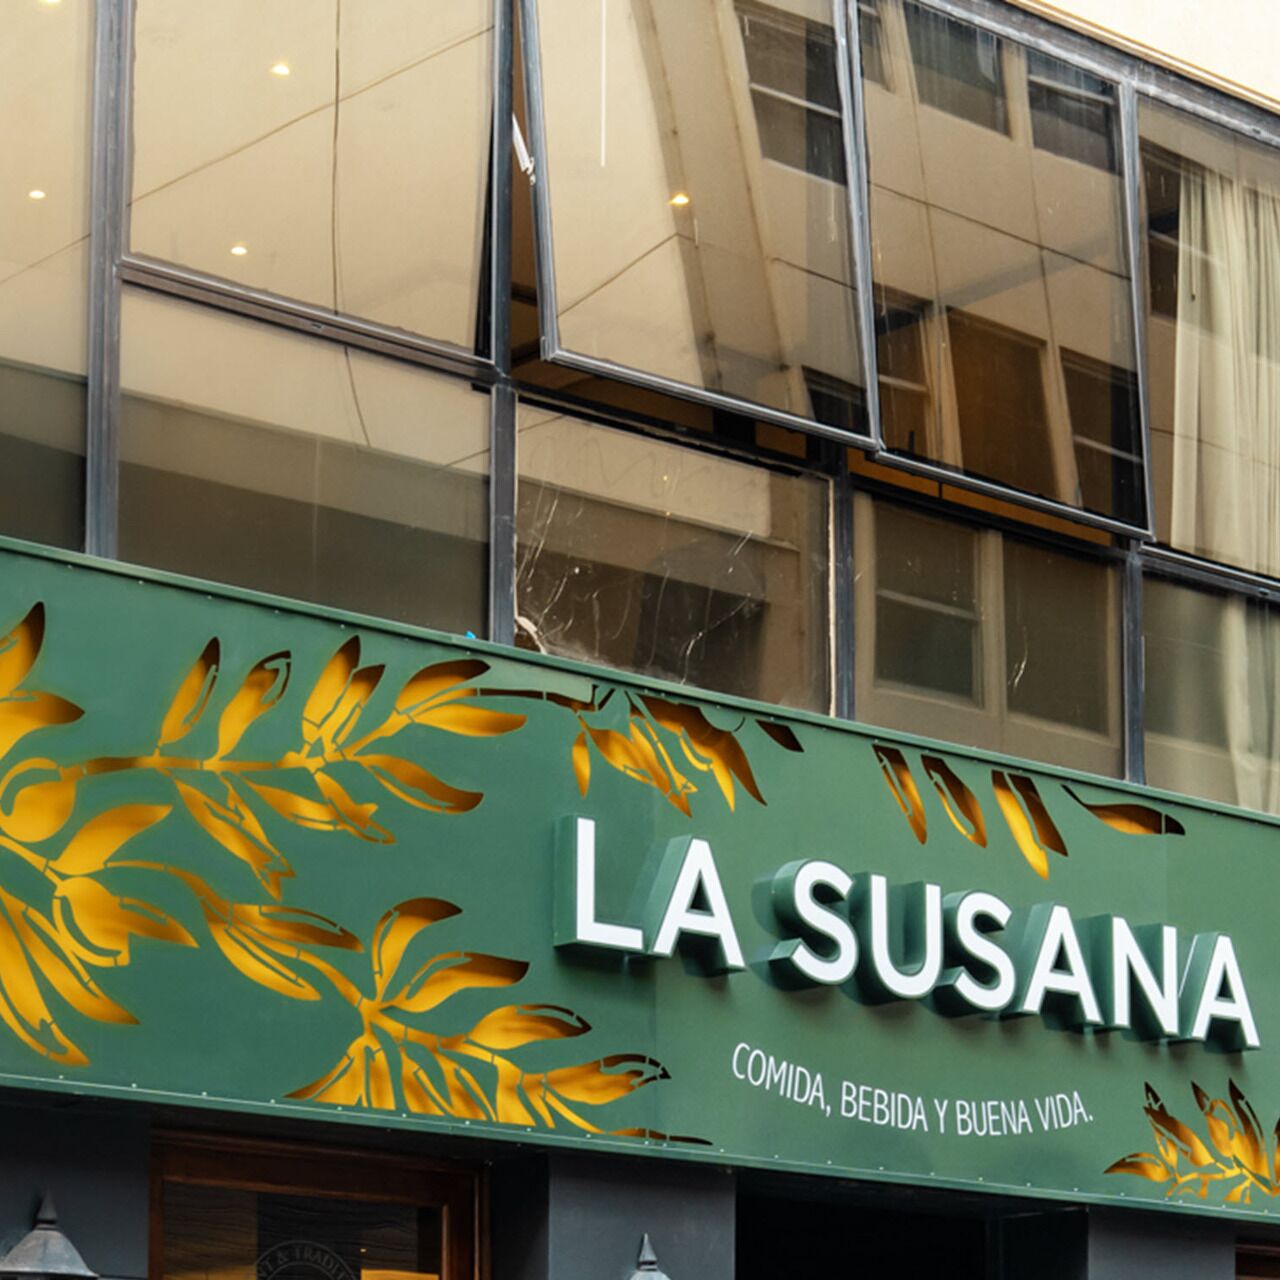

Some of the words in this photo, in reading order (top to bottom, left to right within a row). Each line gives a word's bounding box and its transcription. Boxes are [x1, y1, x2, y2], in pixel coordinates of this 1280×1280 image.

[574, 817, 746, 971] LA
[790, 858, 1261, 1050] SUSANA
[732, 1042, 831, 1118] COMIDA,
[840, 1080, 929, 1132] BEBIDA
[933, 1098, 949, 1134] Y
[955, 1099, 1034, 1136] BUENA
[1033, 1090, 1094, 1132] VIDA.
